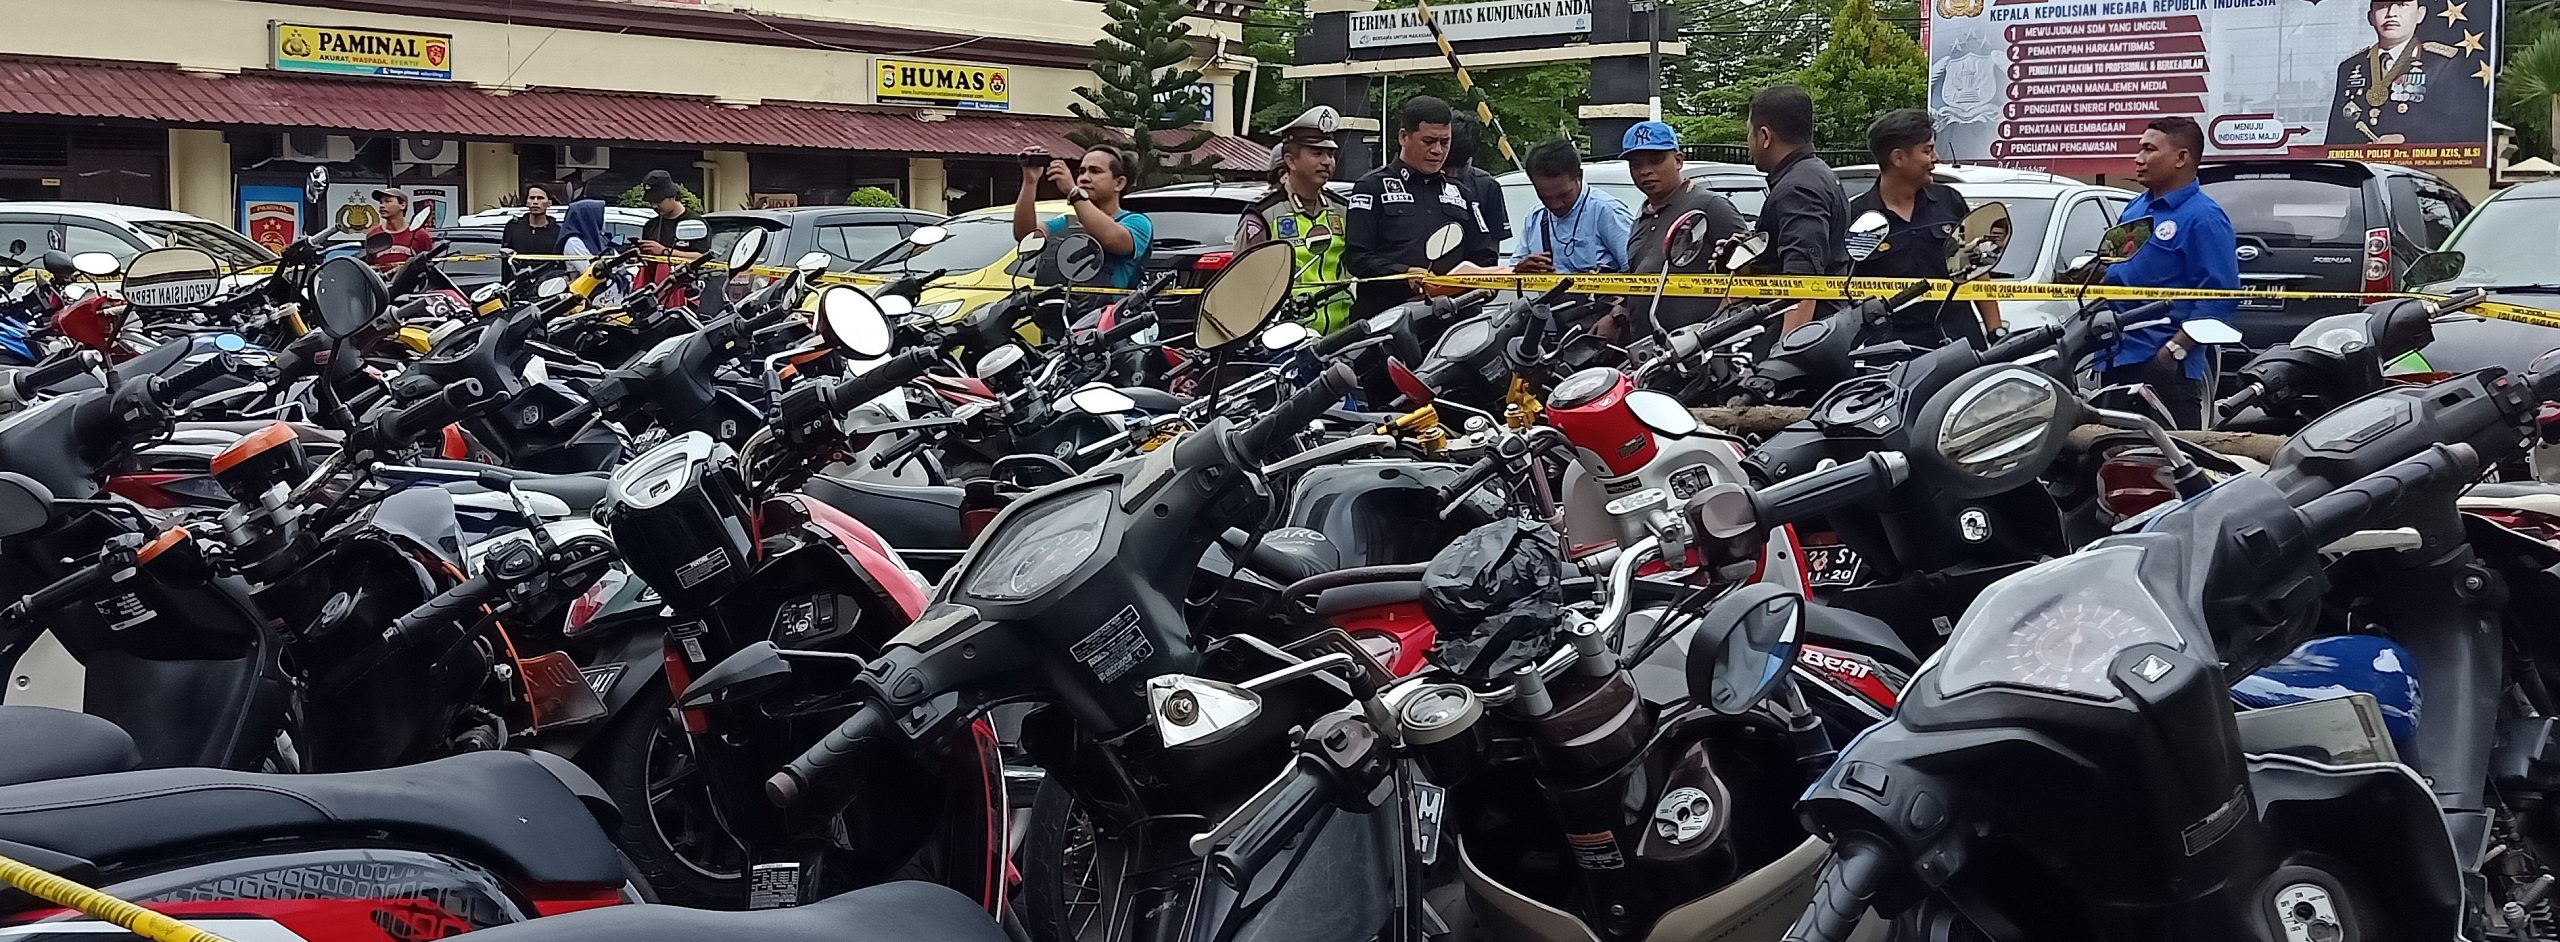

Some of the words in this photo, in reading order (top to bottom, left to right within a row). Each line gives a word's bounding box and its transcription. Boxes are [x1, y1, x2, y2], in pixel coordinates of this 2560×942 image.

[1351, 12, 1396, 31] TERIMA
[1443, 8, 1473, 25] ATAS
[1477, 1, 1551, 23] KUNJUNGAN
[1555, 0, 1592, 16] ANDA
[1990, 8, 2030, 21] KEPALA
[2035, 5, 2097, 19] KEPOLISIAN
[2102, 3, 2147, 16] NEGARA
[2152, 0, 2208, 13] REPUBLIK
[2010, 27, 2017, 40] 1
[2025, 24, 2086, 37] MEWUJUDKAN
[2087, 23, 2106, 35] SDM
[2108, 22, 2131, 33] YANG
[2133, 20, 2168, 31] UNGGUL
[318, 32, 420, 58] PAMINAL
[2012, 46, 2020, 59] 2
[2027, 44, 2084, 57] PEMANTAPAN
[2085, 42, 2155, 54] HARKAMTIBMAS
[319, 54, 351, 63] AKURAT,
[2012, 66, 2020, 79] 3
[2028, 64, 2068, 76] PENGUATAN
[2104, 60, 2148, 73] PROFESIONAL
[2156, 58, 2203, 71] BERKEADILAN
[901, 67, 985, 91] HUMAS
[2011, 85, 2019, 98] 4
[2027, 82, 2083, 95] PEMANTAPAN
[2083, 81, 2139, 94] MANAJEMEN
[2140, 80, 2168, 92] MEDIA
[2008, 104, 2016, 118] 5
[2024, 102, 2072, 115] PENGUATAN
[2073, 102, 2107, 114] SINERGI
[2108, 100, 2160, 113] POLISIONAL
[2003, 124, 2011, 137] 6
[2019, 123, 2061, 135] PENATAAN
[2063, 121, 2126, 134] KELEMBAGAAN
[2234, 122, 2264, 131] MENUJU
[2218, 132, 2257, 142] INDONESIA
[2258, 131, 2280, 141] MAJU
[1995, 142, 2003, 157] 7
[2010, 141, 2058, 154] PENGUATAN
[2060, 141, 2118, 153] PENGAWASAN
[2327, 149, 2364, 160] JENDERAL
[2367, 149, 2391, 159] POLISI
[2394, 149, 2409, 158] Drs.
[2412, 148, 2438, 158] IDHAM
[2440, 148, 2461, 159] AZIS,
[2312, 256, 2352, 264] XENIA
